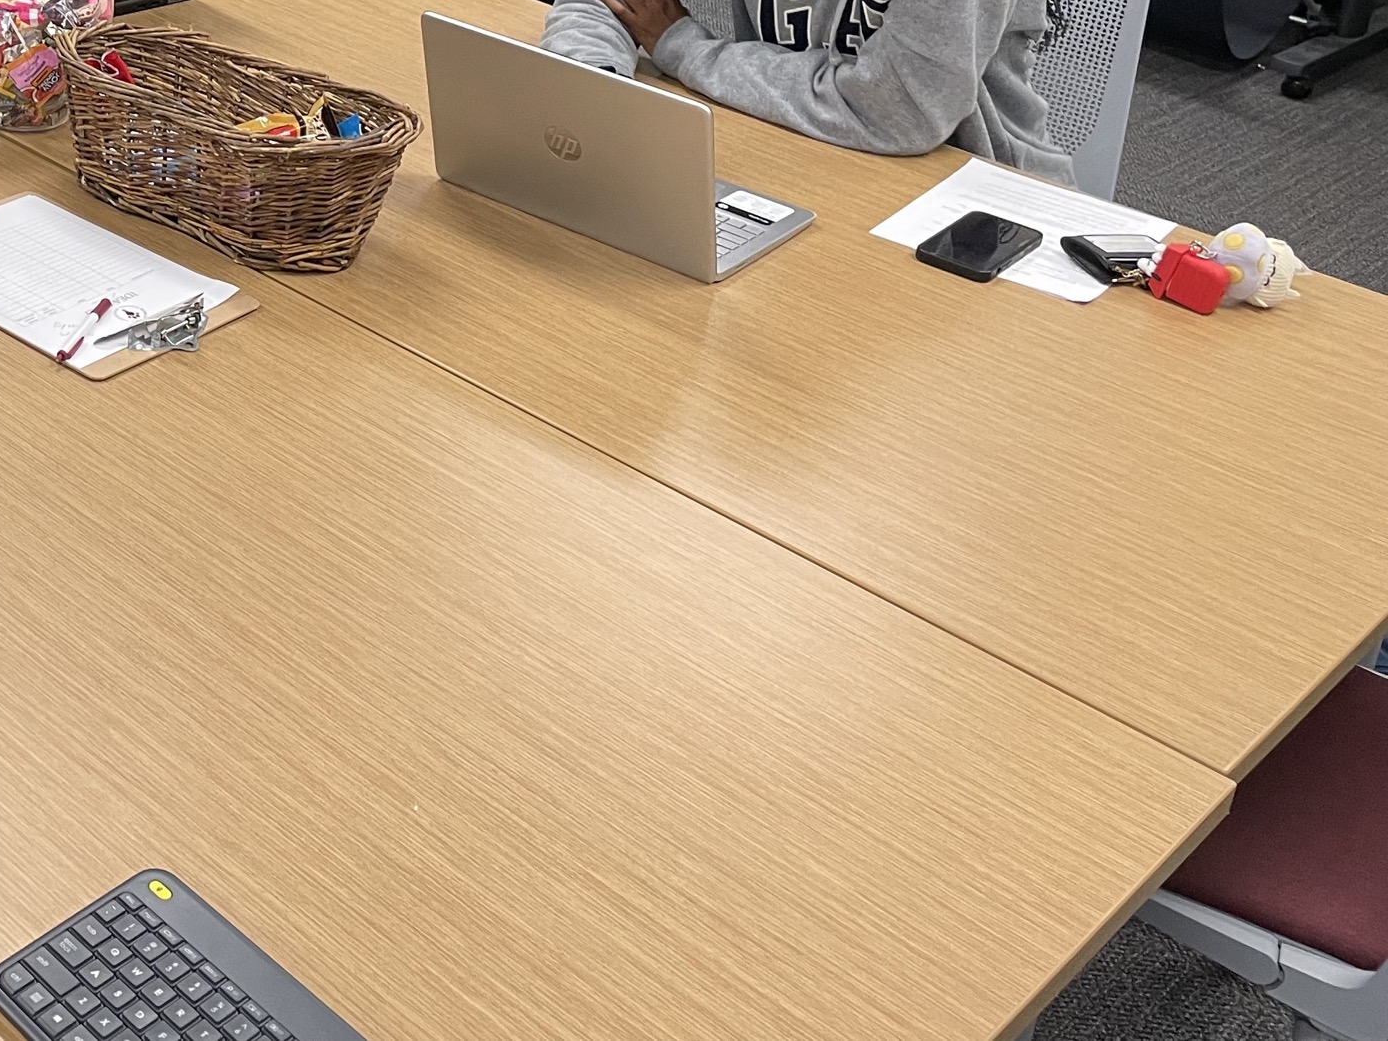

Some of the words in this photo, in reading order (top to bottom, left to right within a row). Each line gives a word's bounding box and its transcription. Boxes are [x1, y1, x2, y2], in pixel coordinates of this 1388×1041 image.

[548, 126, 580, 160] hp
[110, 947, 120, 957] Q
[131, 966, 143, 977] W
[113, 990, 123, 998] S
[153, 988, 164, 998] E
[135, 1011, 145, 1019] D
[175, 1009, 186, 1018] R
[99, 1018, 111, 1027] X
